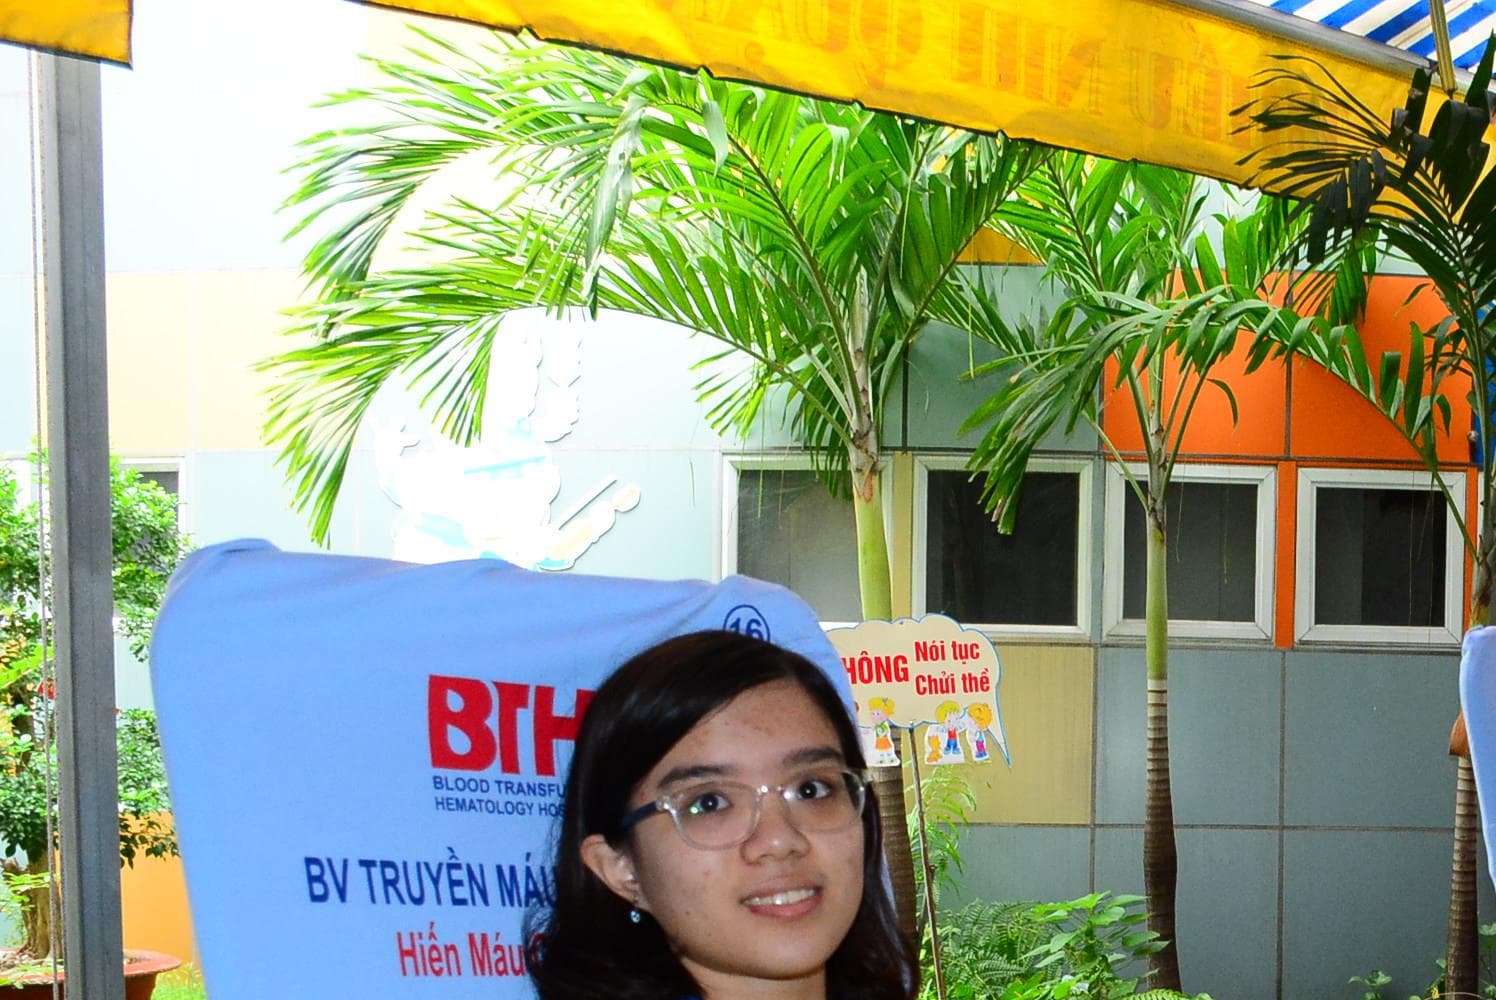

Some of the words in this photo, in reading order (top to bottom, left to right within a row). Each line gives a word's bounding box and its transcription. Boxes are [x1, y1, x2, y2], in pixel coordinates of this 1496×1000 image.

[841, 650, 910, 685] HÔNG
[914, 640, 945, 662] Nói
[951, 640, 980, 665] tục
[915, 671, 956, 695] Chửi
[962, 668, 990, 693] thề
[428, 674, 598, 777] BTH
[433, 776, 490, 793] BLOOD
[495, 780, 567, 798] TRANSFU
[435, 796, 534, 816] HEMATOLOGY
[539, 803, 566, 817] HOS
[304, 856, 349, 903] BV
[358, 846, 490, 907] TRUYỀN
[396, 921, 462, 977] Hiến
[468, 932, 525, 977] Máu
